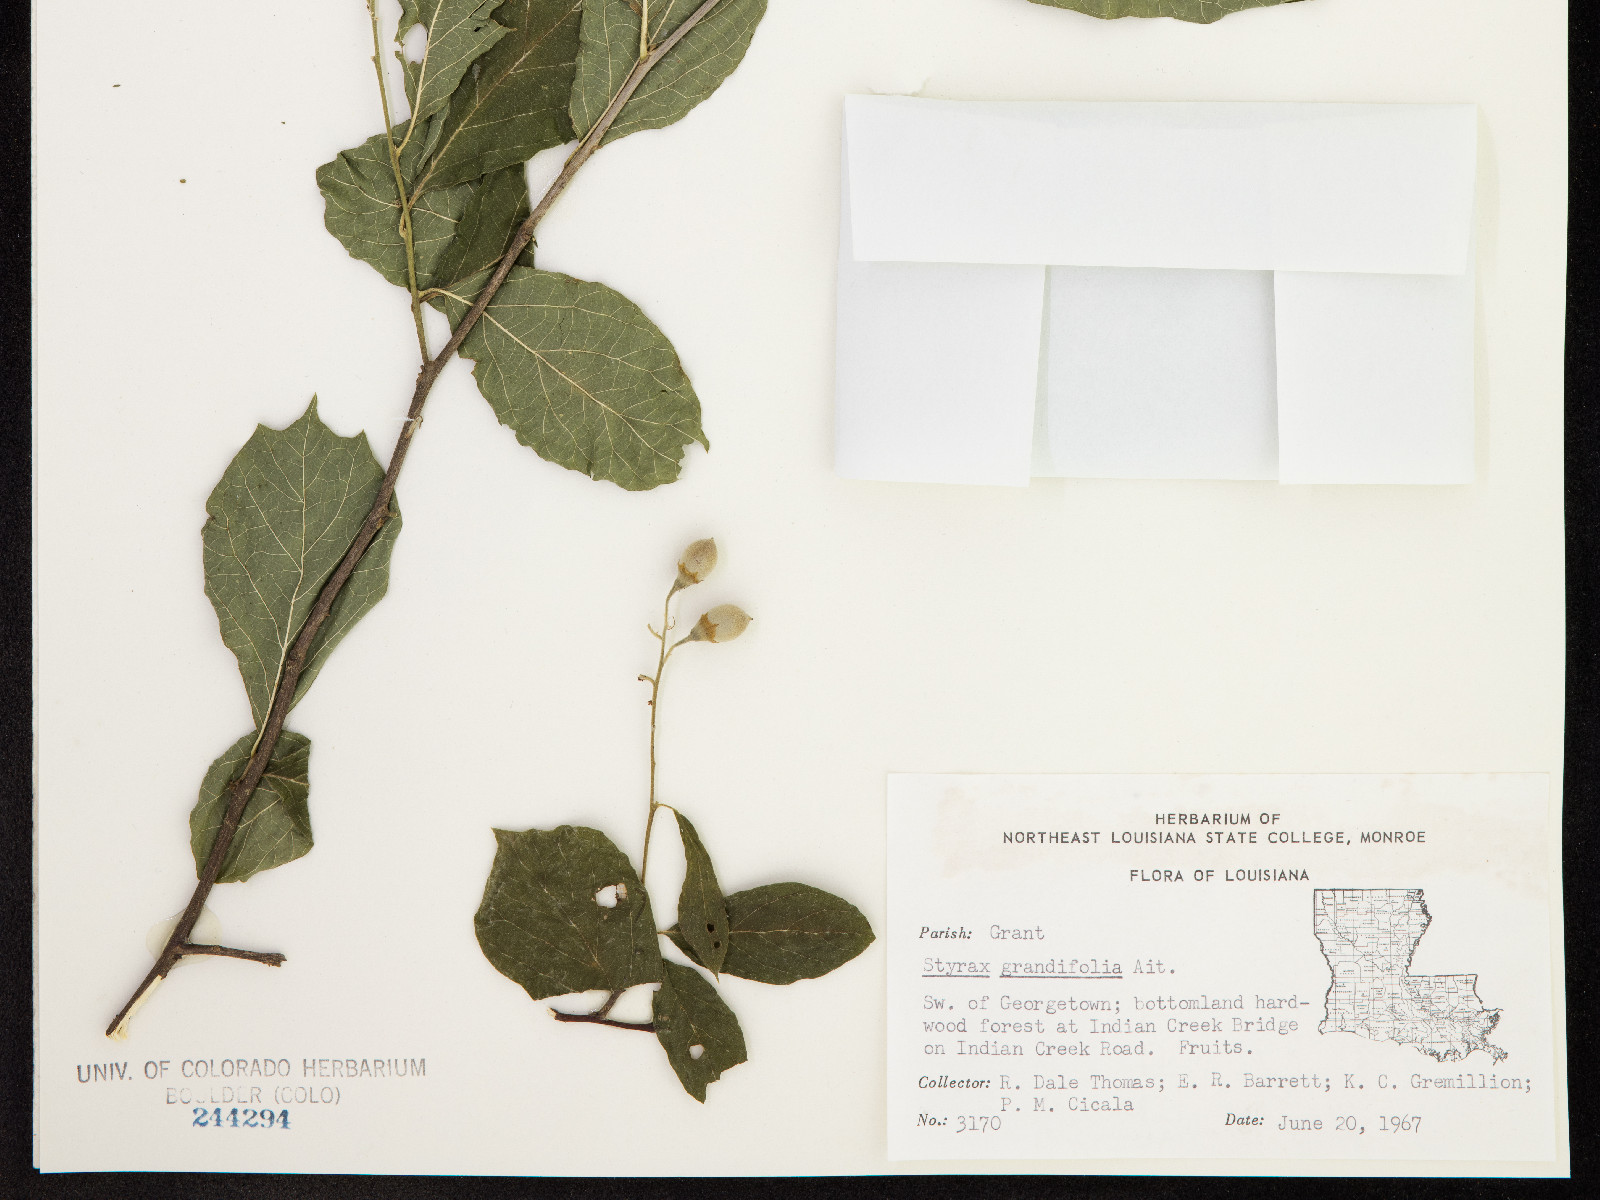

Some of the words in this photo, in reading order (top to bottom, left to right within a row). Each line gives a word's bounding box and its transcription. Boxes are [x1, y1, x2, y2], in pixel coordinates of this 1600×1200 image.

[1155, 813, 1251, 825] HERBARIUM
[1259, 812, 1281, 825] OF
[1002, 831, 1101, 844] NORTHEAST
[1111, 831, 1197, 844] LOUISIANA
[1205, 831, 1258, 844] STATE
[1267, 831, 1351, 846] COLLEGE,
[1360, 830, 1426, 844] MONROE
[1130, 869, 1185, 882] FLORA
[1193, 869, 1215, 882] OF
[1225, 868, 1310, 882] LOUISIANA
[918, 926, 973, 939] Parish:
[990, 924, 1045, 940] Grant
[923, 957, 991, 976] Styrax
[1001, 958, 1123, 977] grandifolia
[1132, 959, 1176, 974] Ait.
[923, 995, 954, 1011] Sw.
[968, 995, 990, 1010] of
[1000, 995, 1120, 1015] Georgetown;
[1133, 994, 1245, 1011] bottomland
[1255, 994, 1310, 1009] hard-
[922, 1018, 968, 1033] wood
[980, 1018, 1045, 1034] forest
[1056, 1019, 1078, 1034] at
[1089, 1018, 1157, 1034] Indian
[1167, 1017, 1223, 1033] Creek
[1231, 1017, 1299, 1036] Bridge
[924, 1043, 946, 1055] on
[956, 1040, 1024, 1056] Indian
[1035, 1041, 1091, 1056] Creek
[1099, 1040, 1154, 1056] Road.
[1179, 1039, 1253, 1055] Fruits.
[76, 1061, 133, 1084] UNIV.
[144, 1060, 172, 1080] OF
[181, 1058, 292, 1079] COLORADO
[302, 1057, 427, 1078] HERBARIUM
[918, 1075, 991, 1089] Collector:
[999, 1074, 1021, 1090] R.
[1033, 1074, 1079, 1090] Dale
[1090, 1074, 1165, 1092] Thomas;
[1177, 1073, 1198, 1089] E.
[1211, 1071, 1232, 1089] R.
[1243, 1073, 1331, 1092] Barrett;
[1344, 1073, 1365, 1090] K.
[1377, 1073, 1398, 1090] C.
[1410, 1073, 1532, 1093] Gremillion;
[274, 1086, 341, 1106] (COLO)
[1000, 1097, 1021, 1112] P.
[1033, 1097, 1054, 1113] M.
[1068, 1096, 1135, 1112] Cicala
[192, 1107, 292, 1130] 244294
[917, 1113, 948, 1127] No.:
[956, 1115, 1002, 1133] 3170
[1225, 1112, 1265, 1127] Date:
[1277, 1115, 1323, 1131] June
[1335, 1115, 1365, 1135] 20,
[1379, 1114, 1422, 1134] 1967
